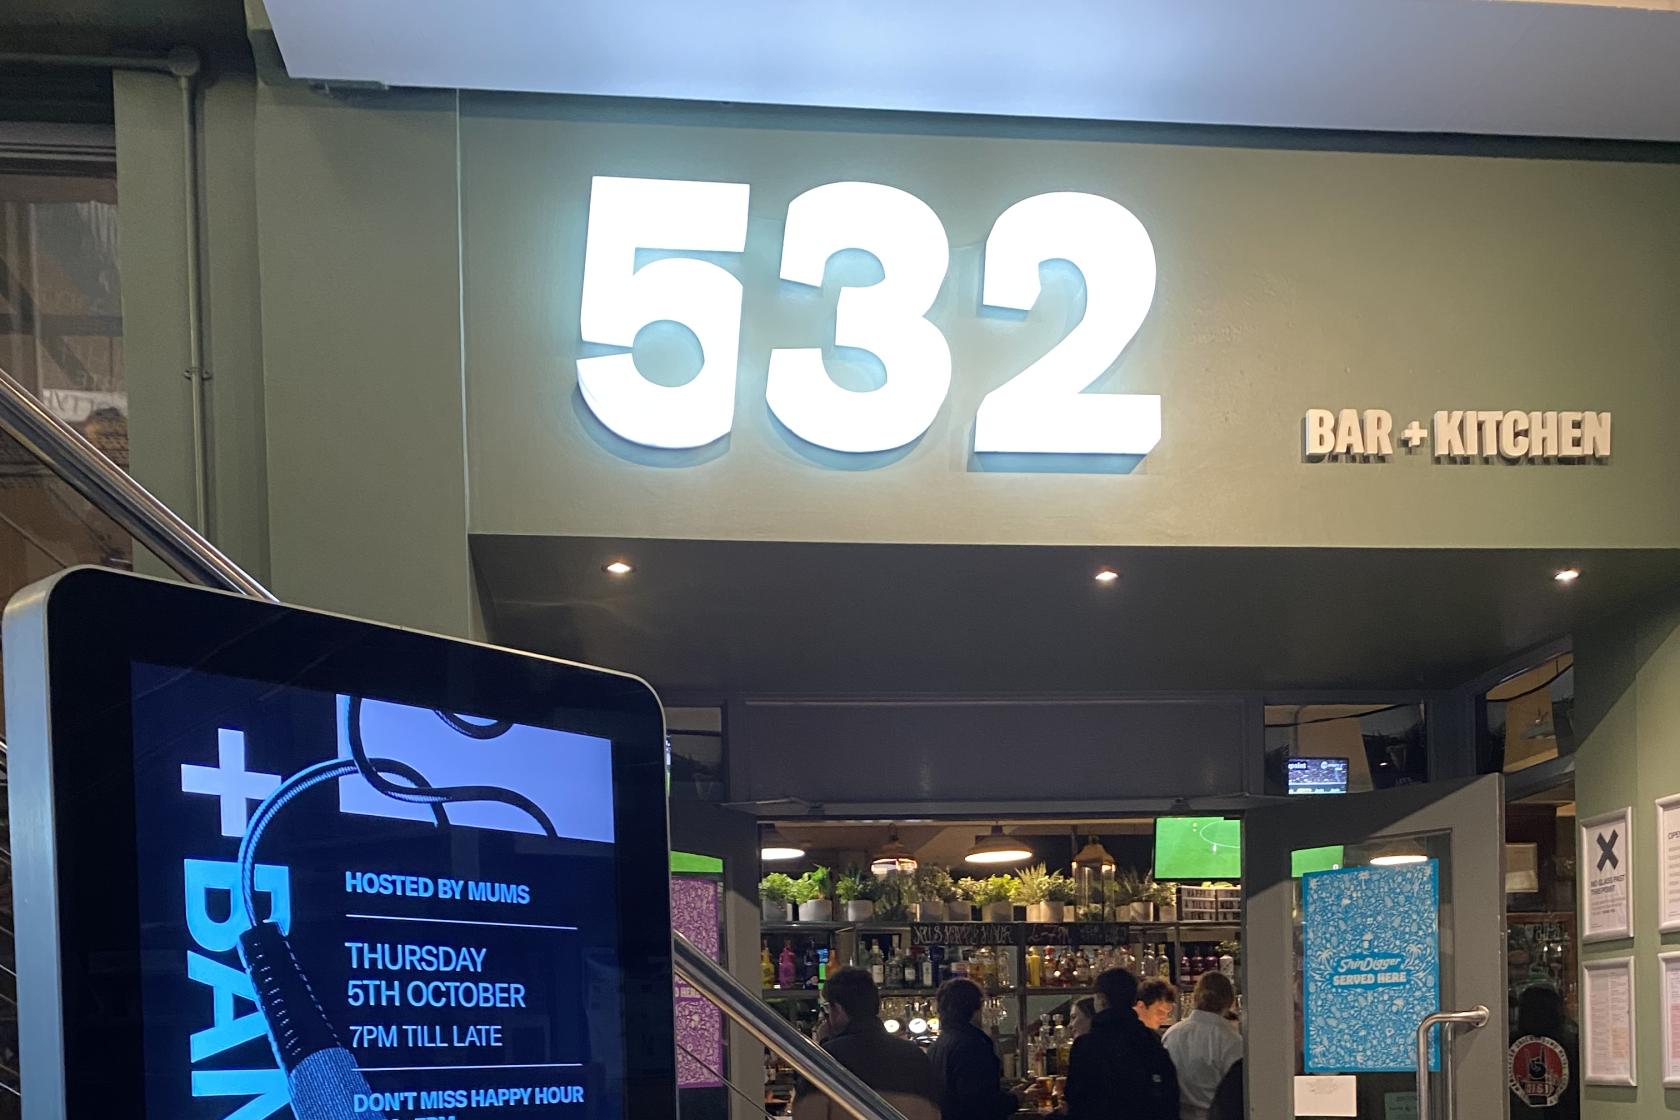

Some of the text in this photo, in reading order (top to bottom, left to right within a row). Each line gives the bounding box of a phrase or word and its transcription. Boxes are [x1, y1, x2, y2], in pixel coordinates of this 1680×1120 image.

[576, 175, 1162, 455] 532
[1305, 408, 1393, 457] BAR
[1433, 410, 1612, 459] KITCHEN
[345, 871, 530, 904] HOSTED BY MUMS
[344, 942, 487, 973] THURSDAY
[1337, 957, 1401, 973] ShinDigger
[1333, 971, 1407, 986] SERVED HERE
[348, 980, 526, 1008] 5TH OCTOBER
[349, 1025, 503, 1048] 7PM TILL LATE
[353, 1085, 584, 1113] DON'T MISS HAPPY HOUR
